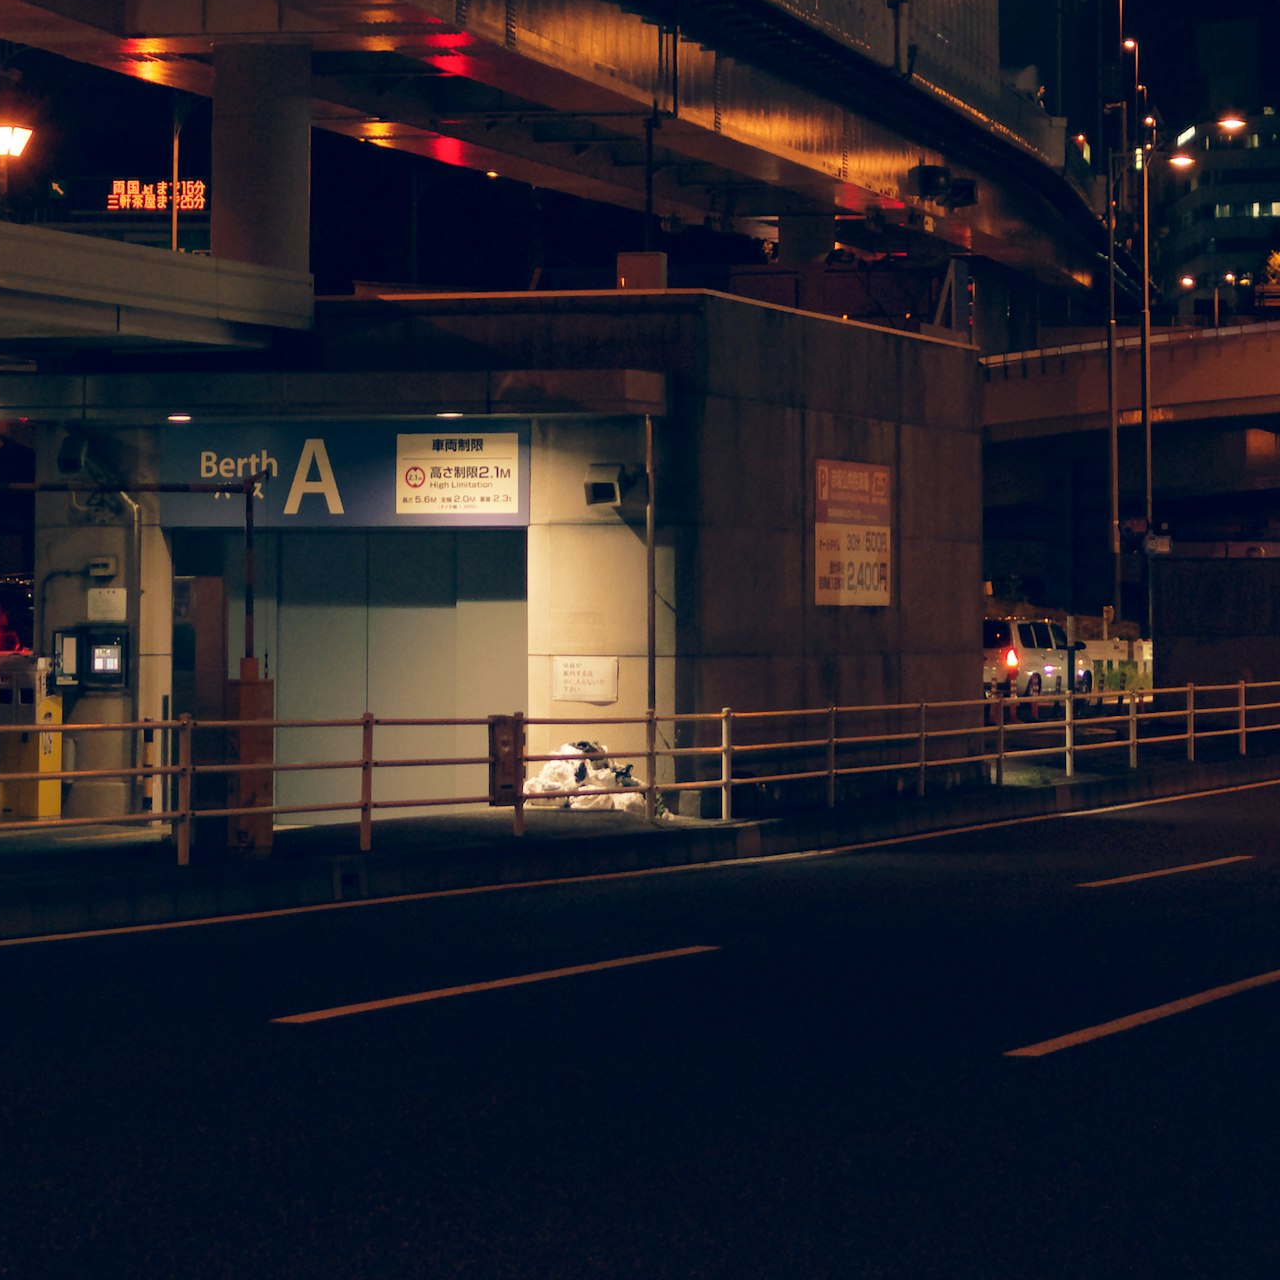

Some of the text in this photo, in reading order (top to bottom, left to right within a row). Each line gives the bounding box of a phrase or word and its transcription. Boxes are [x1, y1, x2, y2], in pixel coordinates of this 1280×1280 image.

[432, 438, 484, 452] 車両制限
[200, 438, 345, 515] Berth A
[430, 465, 511, 479] 高さ制限2.1M
[451, 481, 493, 489] Limitation
